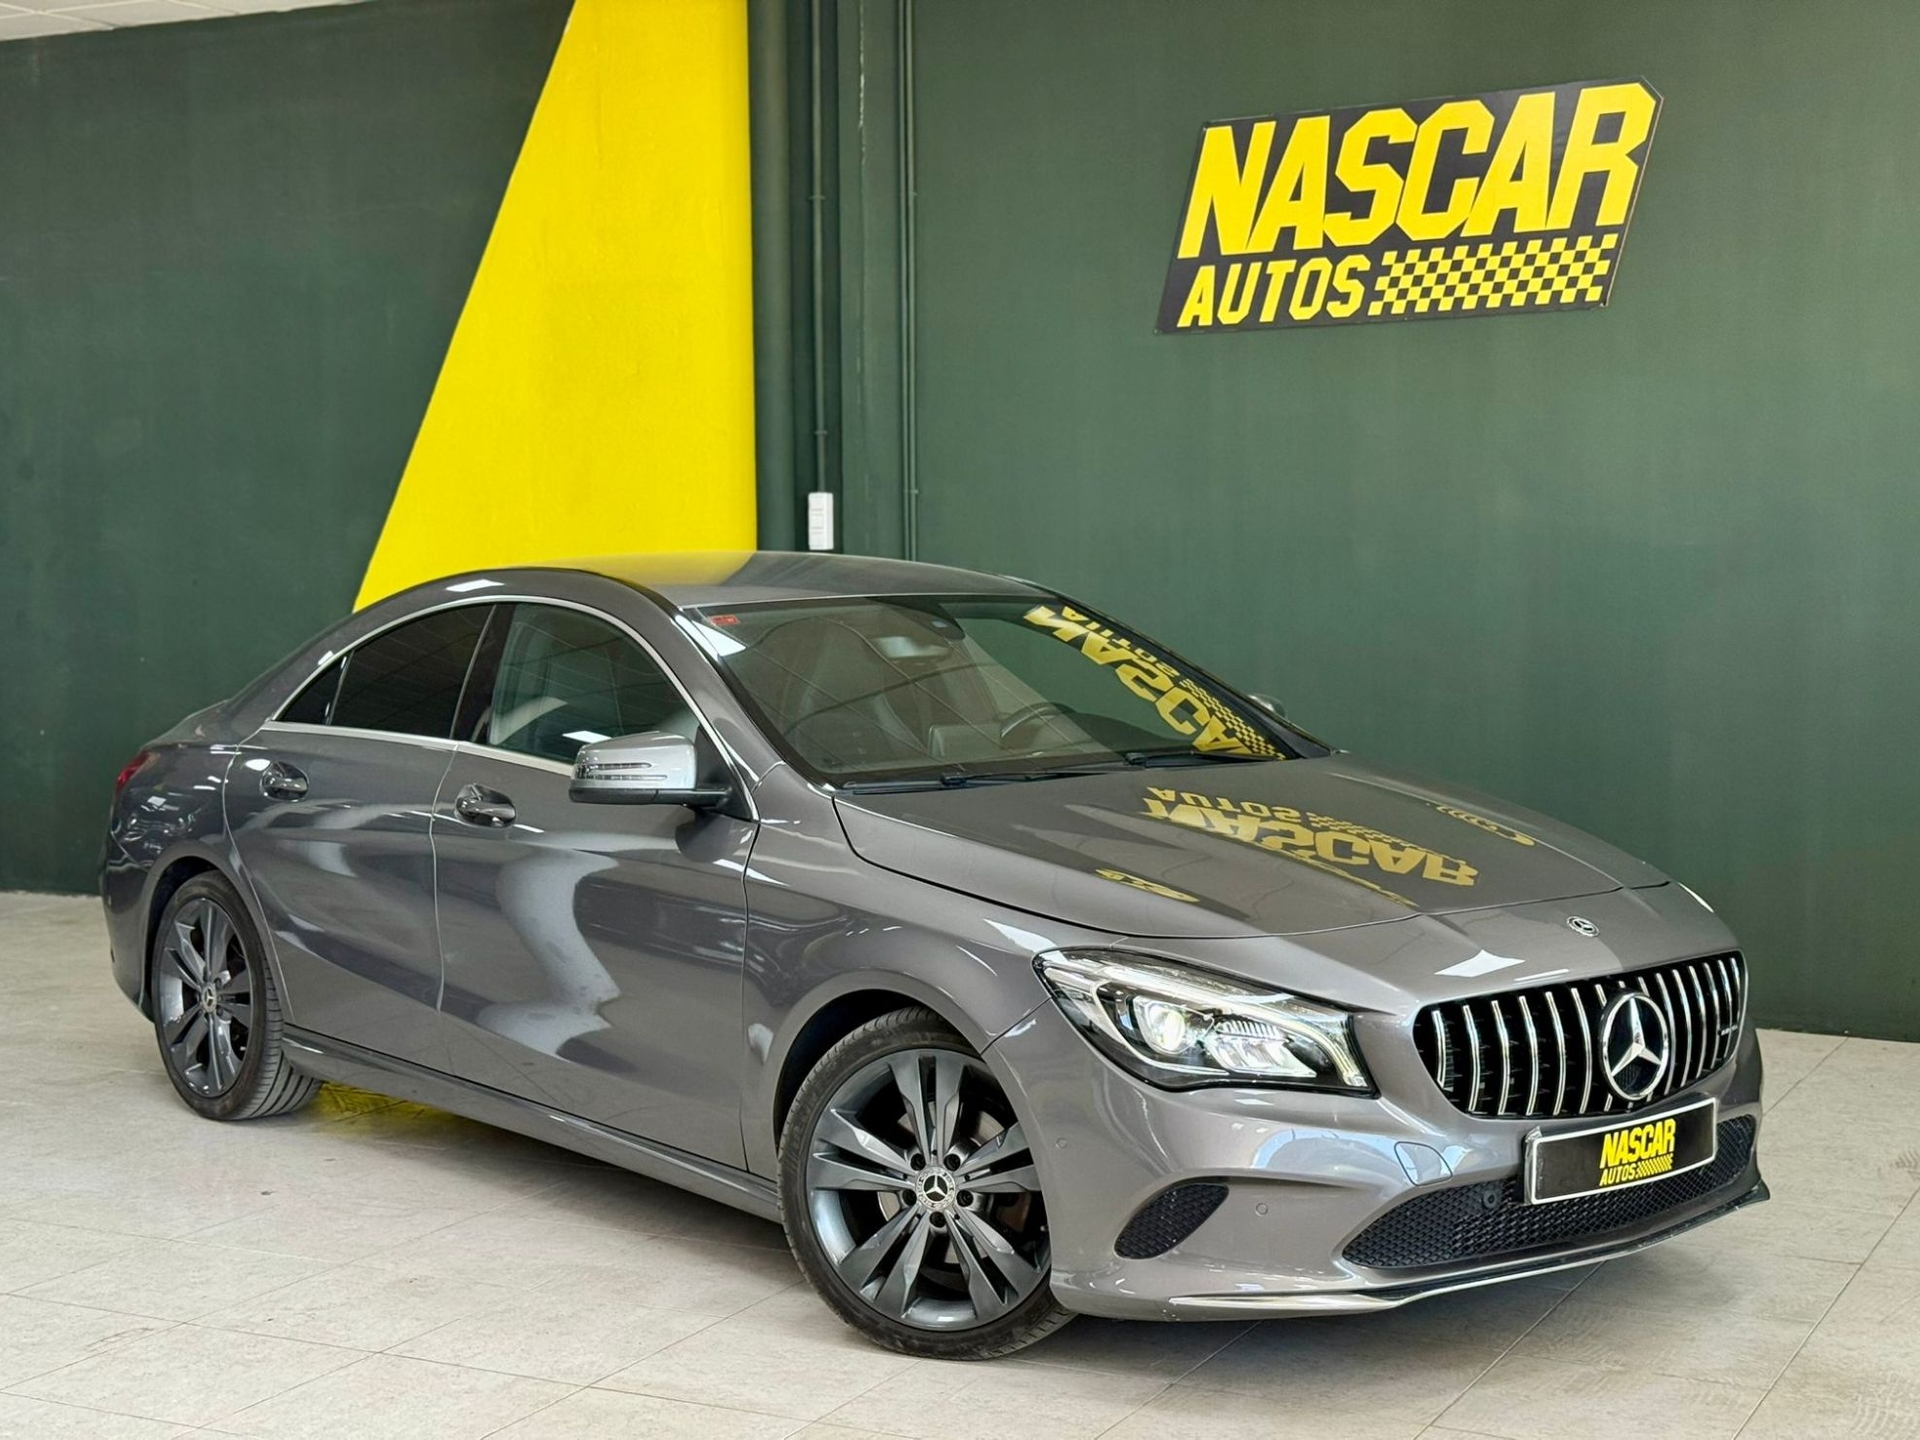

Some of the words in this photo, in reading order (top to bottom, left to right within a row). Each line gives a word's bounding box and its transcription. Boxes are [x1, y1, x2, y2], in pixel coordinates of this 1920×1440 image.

[1177, 82, 1656, 258] NASCAR
[1177, 255, 1370, 327] AUTOS
[1600, 1118, 1676, 1168] NASCAR
[1599, 1163, 1637, 1186] AUTOS
